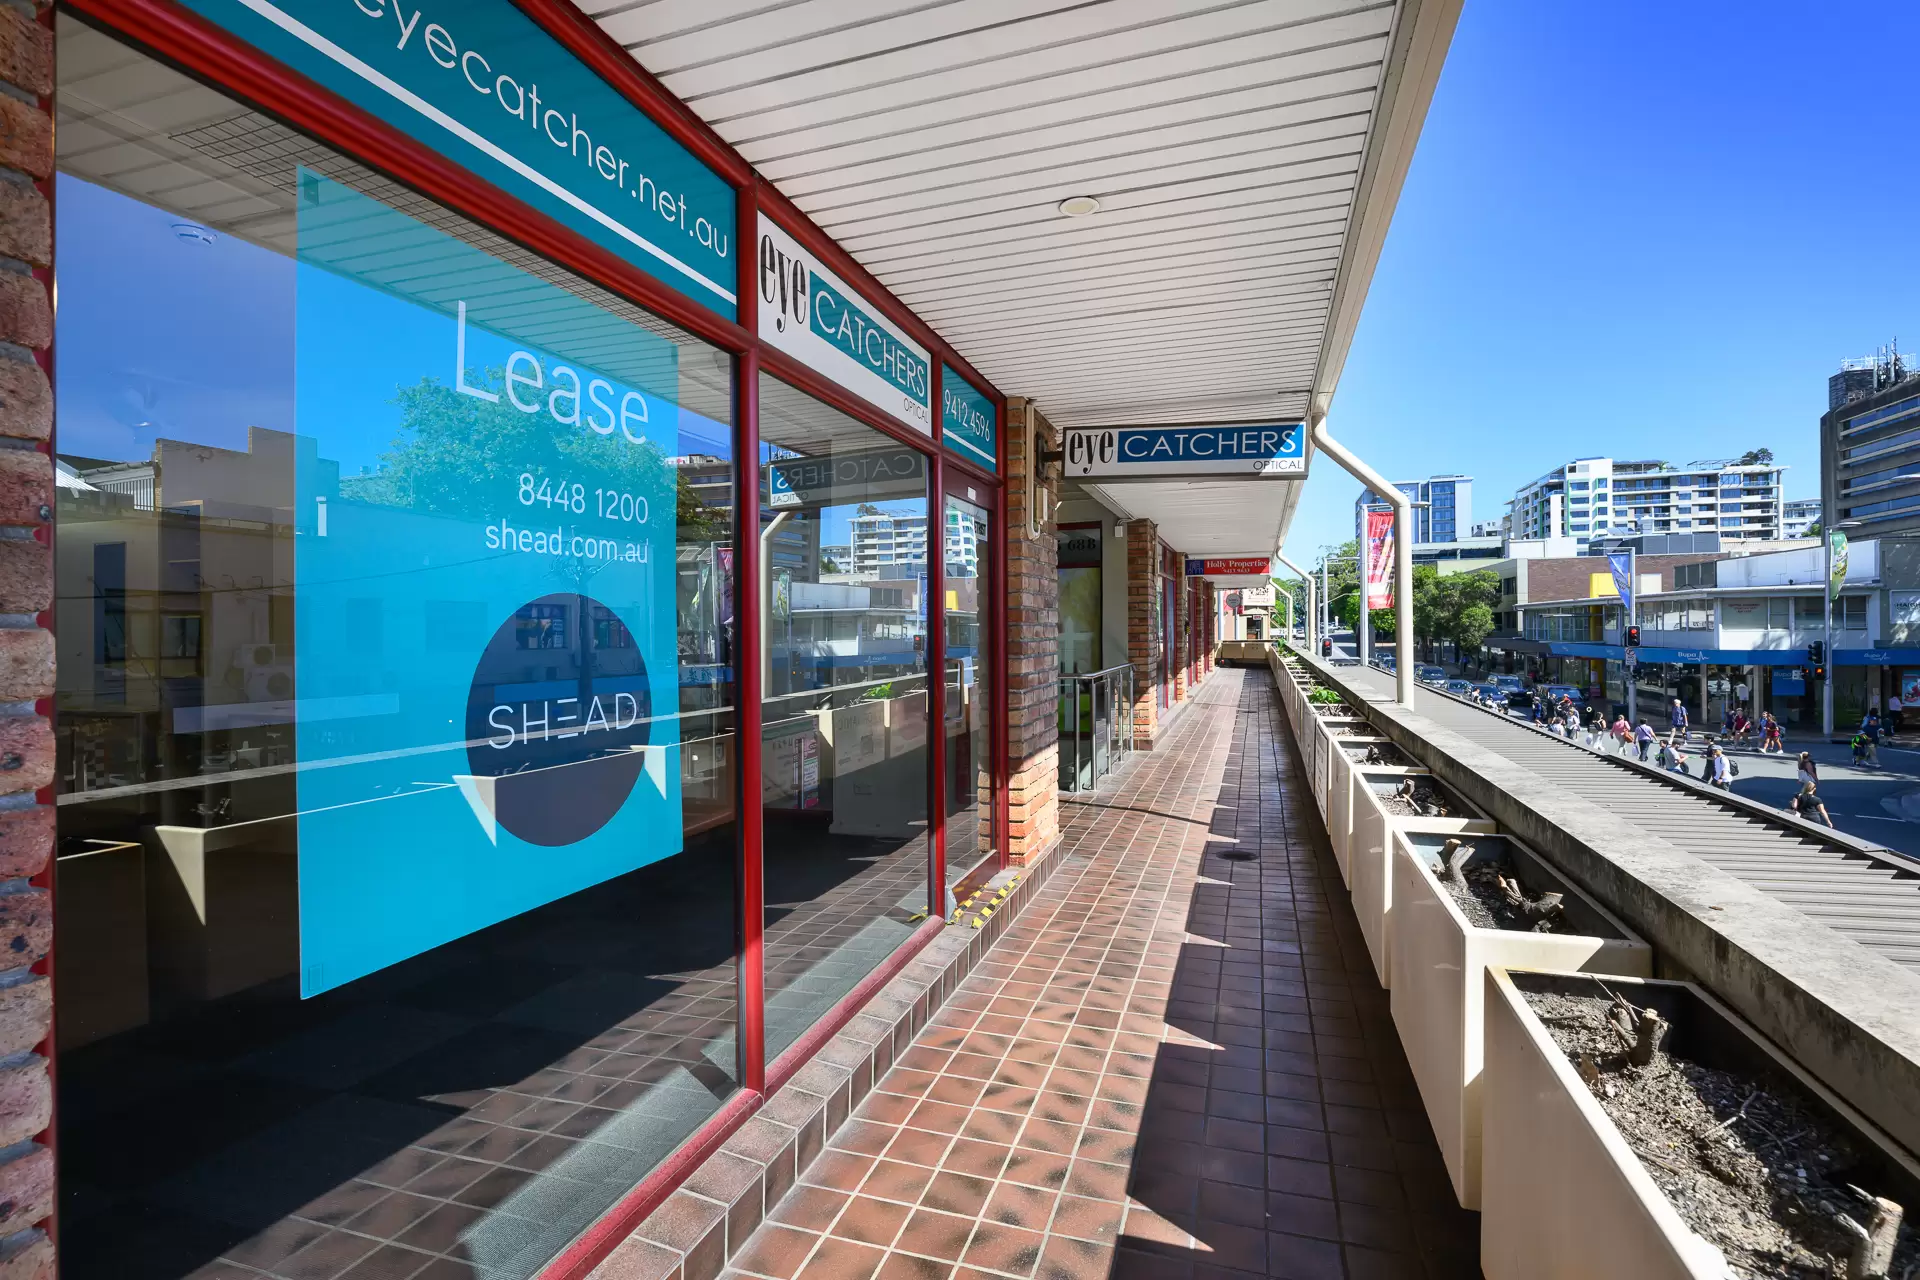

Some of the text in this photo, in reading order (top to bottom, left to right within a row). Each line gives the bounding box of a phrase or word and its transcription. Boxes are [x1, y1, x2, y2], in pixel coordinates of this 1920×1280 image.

[760, 234, 925, 397] eye CATCHERS
[455, 300, 649, 445] Lease
[903, 397, 929, 424] OPTICAL
[944, 389, 991, 442] 9412 4596
[1068, 429, 1297, 474] eye CATCHERS
[1252, 459, 1303, 471] OPTICAL
[519, 472, 649, 524] 8448 1200
[485, 518, 649, 564] shead.com.au
[1206, 559, 1268, 570] Holly Properties
[488, 692, 637, 750] SHEAD
